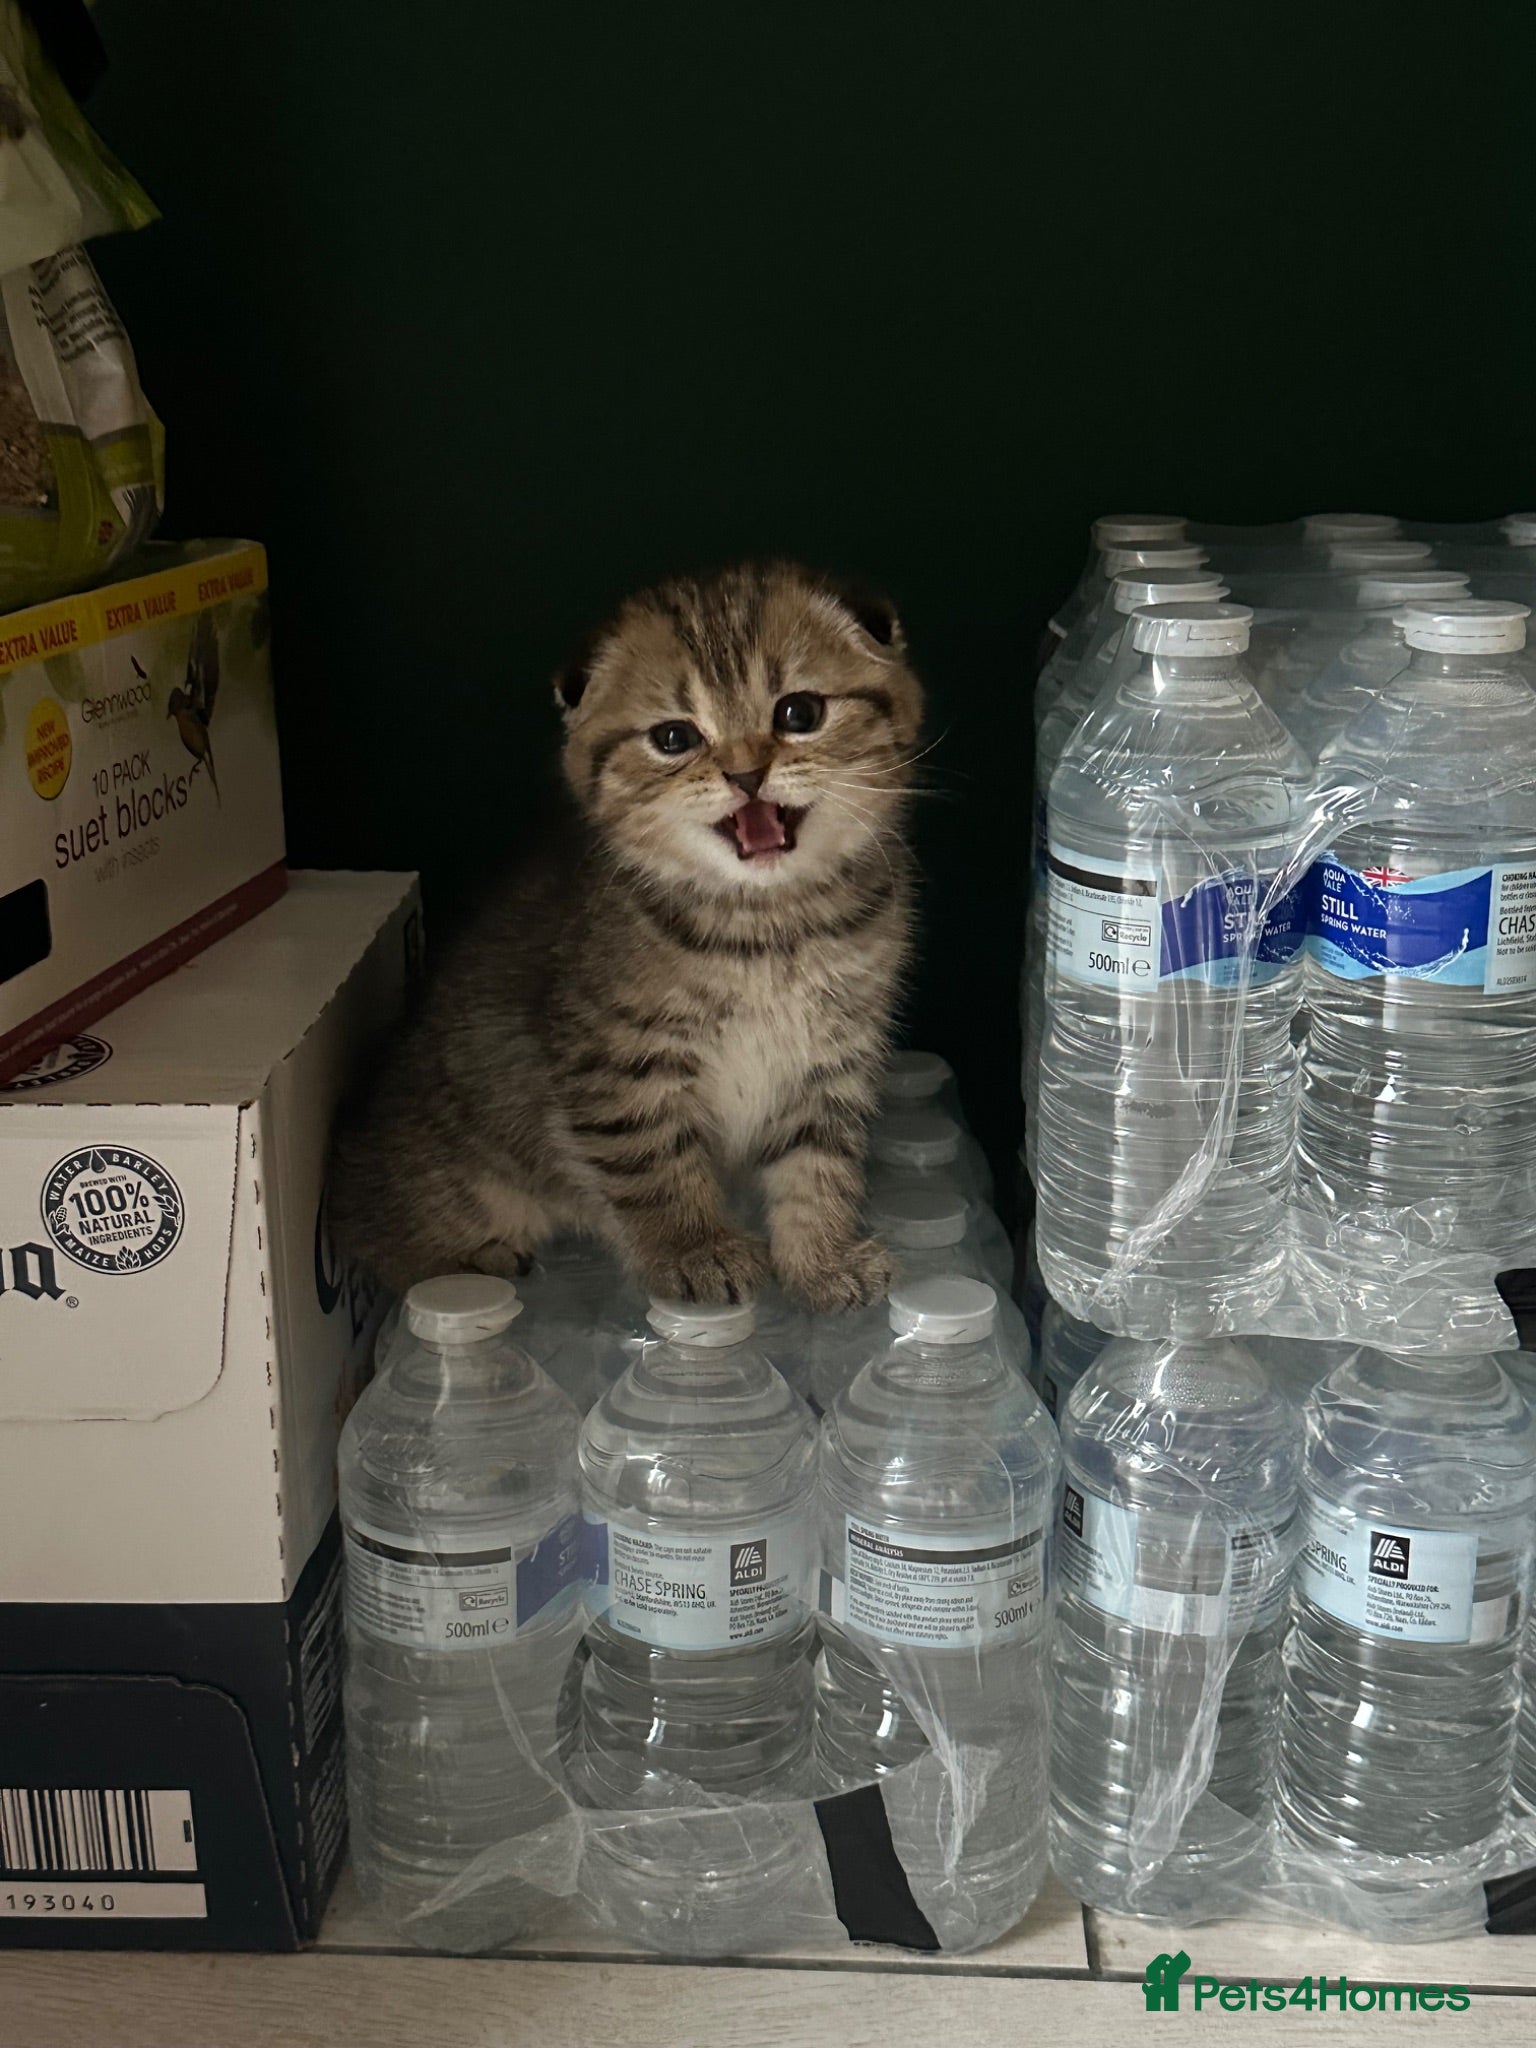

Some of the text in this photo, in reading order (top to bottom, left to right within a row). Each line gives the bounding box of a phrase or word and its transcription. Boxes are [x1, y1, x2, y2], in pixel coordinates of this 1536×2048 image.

[198, 568, 255, 602] EXTRA VALUE
[106, 592, 177, 631] EXTRA VALUE
[39, 620, 78, 651] VALUE
[93, 749, 152, 797] 10 PACK
[55, 773, 188, 869] suet blocks
[1323, 868, 1346, 884] AQUA
[1323, 879, 1342, 893] VALE
[1226, 883, 1254, 897] AQU
[1321, 894, 1359, 920] STILL
[1264, 921, 1291, 937] WATER
[1320, 913, 1387, 939] SPRING WATER
[1088, 951, 1130, 975] 500ml
[49, 1153, 168, 1202] WATER BARLEY
[108, 1174, 127, 1184] WITH
[69, 1181, 149, 1219] 100%
[78, 1210, 155, 1235] NATURAL
[65, 1228, 173, 1268] MAIZE HOPS
[88, 1226, 154, 1246] INGREDIENTS
[734, 1566, 763, 1581] ALDI
[1373, 1558, 1405, 1574] ALDI
[615, 1569, 652, 1595] CHASE
[445, 1620, 490, 1639] 500ml
[6, 1893, 116, 1911] 193040
